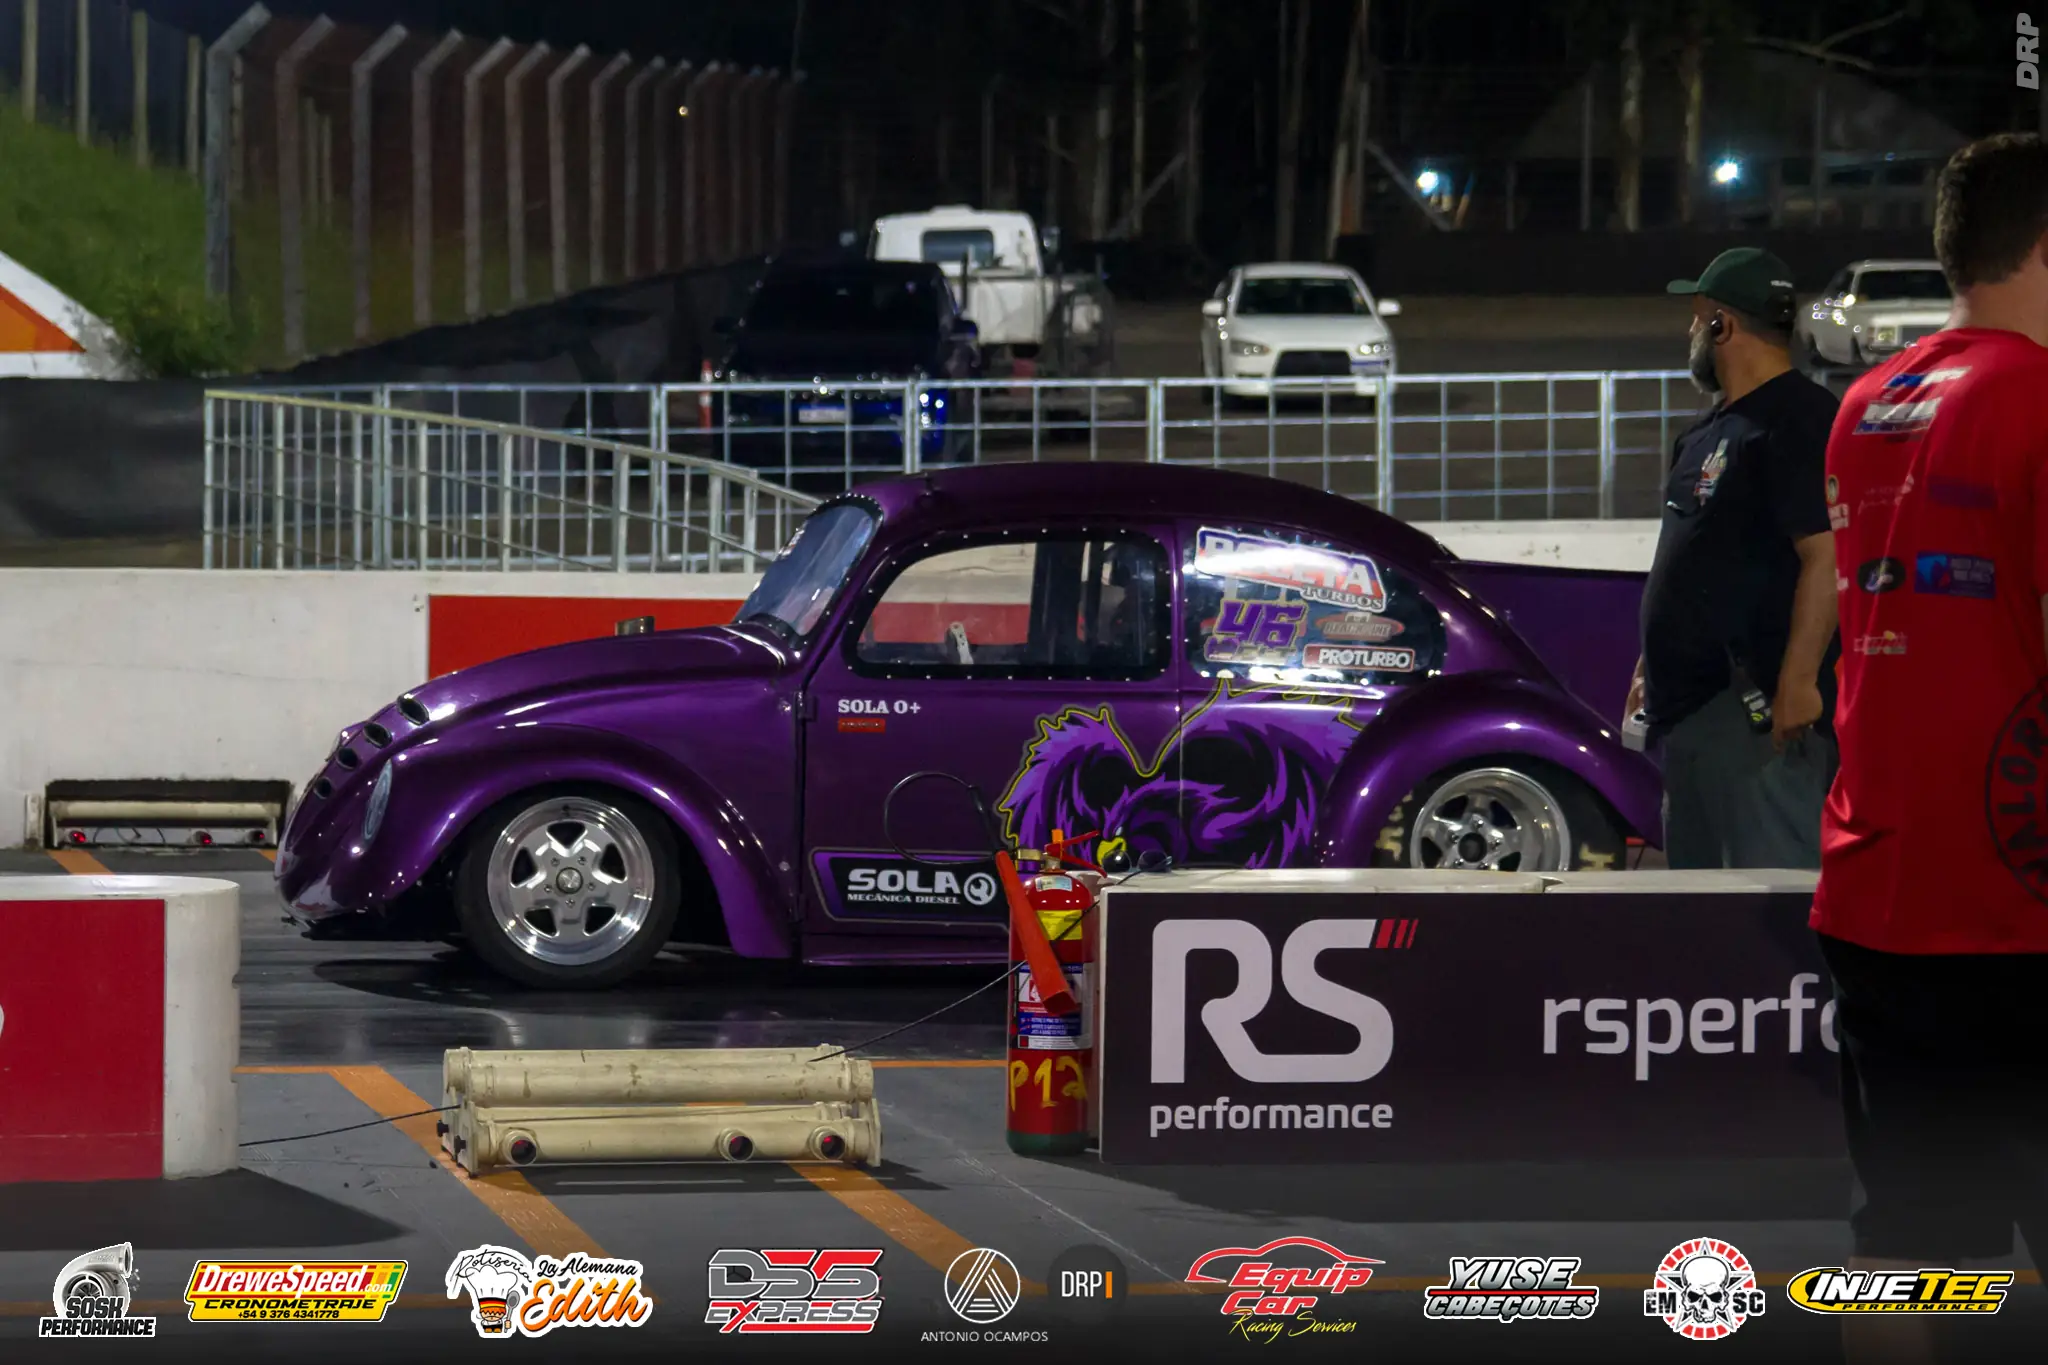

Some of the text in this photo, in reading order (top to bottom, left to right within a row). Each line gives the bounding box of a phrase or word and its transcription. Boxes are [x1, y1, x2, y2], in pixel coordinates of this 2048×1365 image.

[1304, 586, 1383, 609] TURBOS
[1214, 601, 1306, 648] 46
[1319, 649, 1410, 669] PROTURBO
[838, 699, 889, 714] SOLA
[848, 869, 961, 894] SOLA
[915, 894, 961, 905] DIESEL
[1151, 919, 1394, 1083] RS
[1009, 1058, 1087, 1112] P12
[1150, 1096, 1393, 1138] performance
